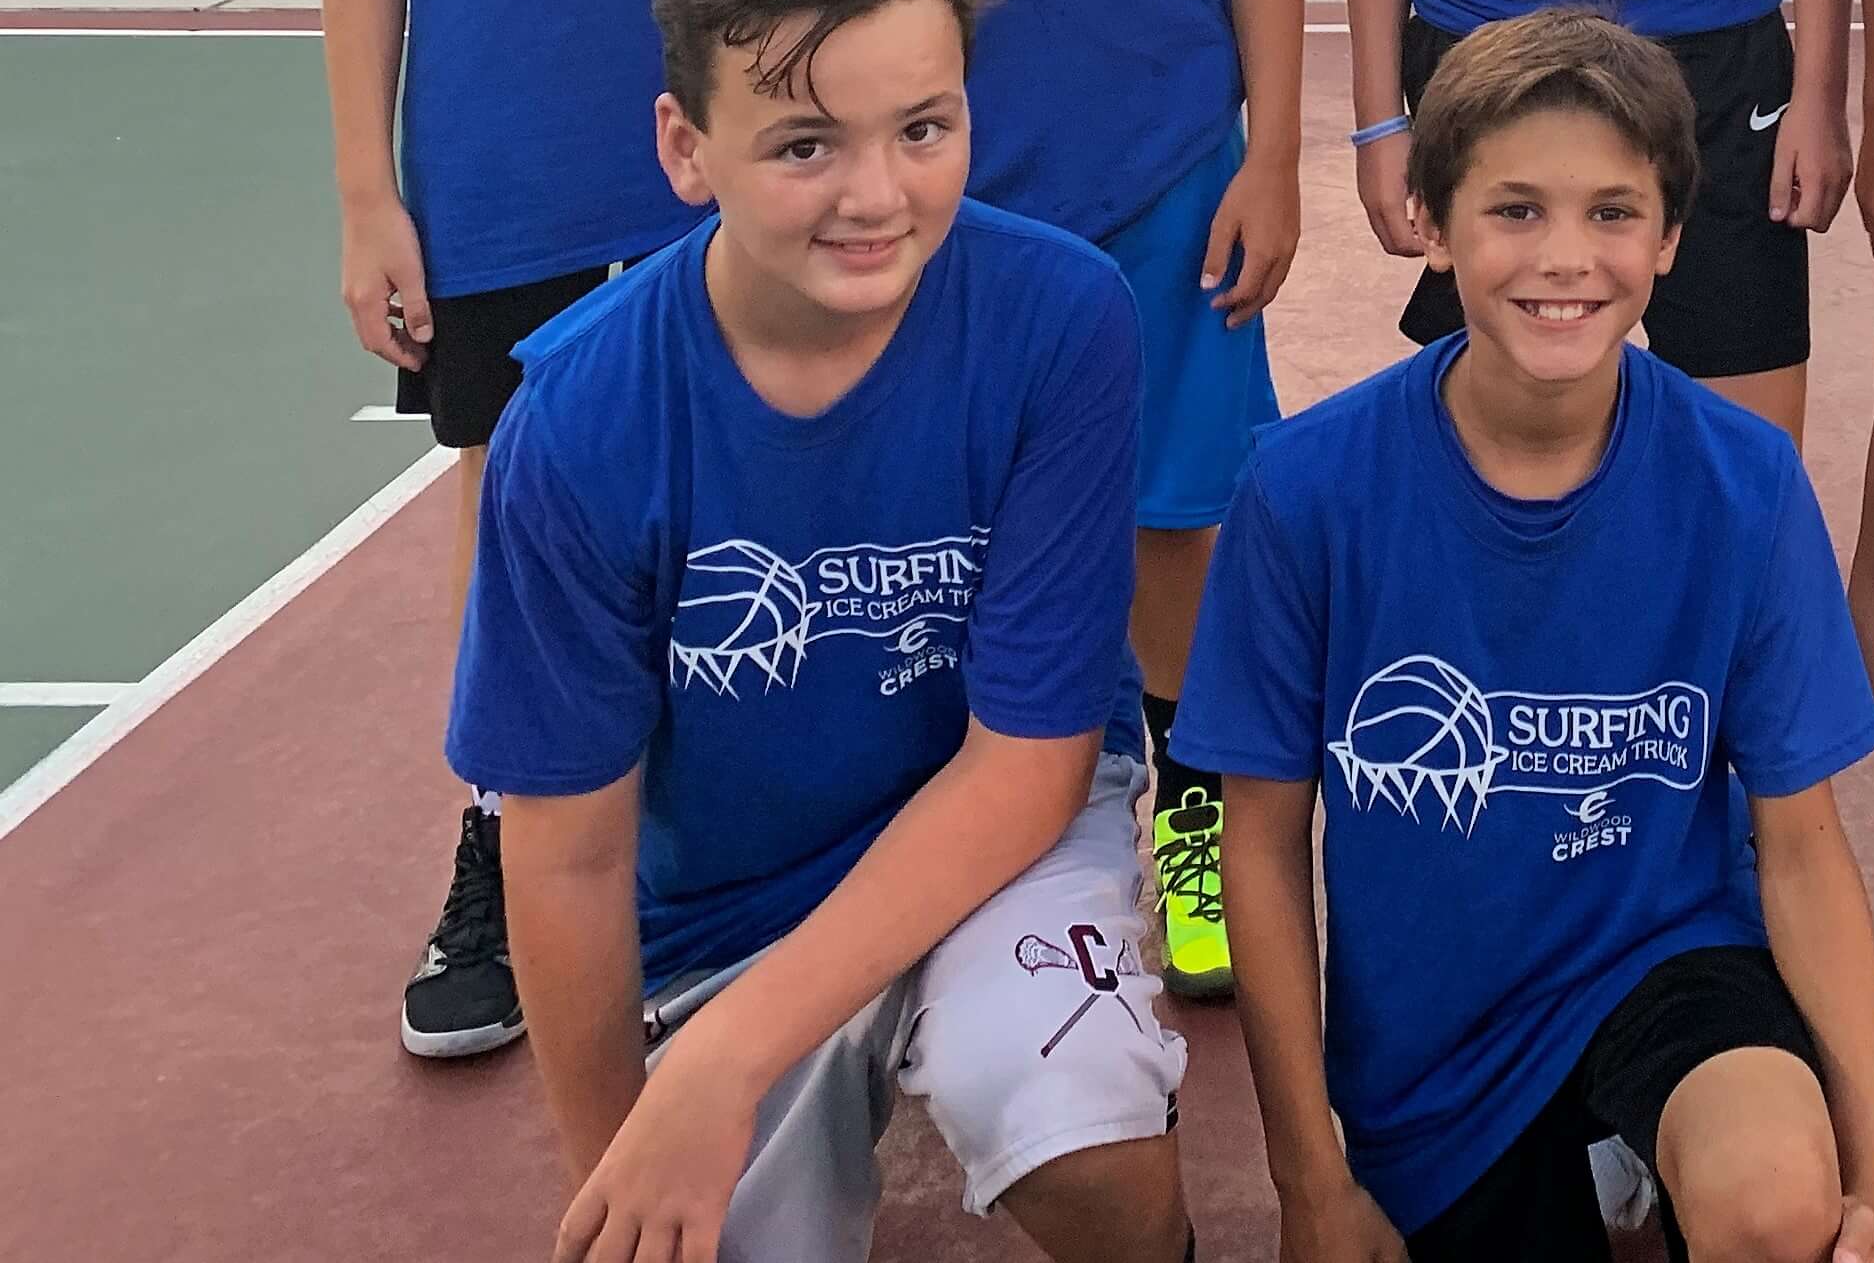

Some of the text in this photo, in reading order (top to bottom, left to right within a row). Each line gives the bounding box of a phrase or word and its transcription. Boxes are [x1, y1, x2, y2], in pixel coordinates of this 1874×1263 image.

[818, 549, 982, 596] SURFIN
[826, 597, 865, 618] ICE
[867, 587, 944, 620] CREAM
[878, 643, 957, 679] WILDWOOD
[880, 654, 958, 696] CREST
[1508, 694, 1692, 749] SURFING
[1511, 739, 1688, 776] ICE CREAM TRUCK
[1552, 826, 1632, 862] CREST
[1553, 814, 1632, 844] WILDWOOD
